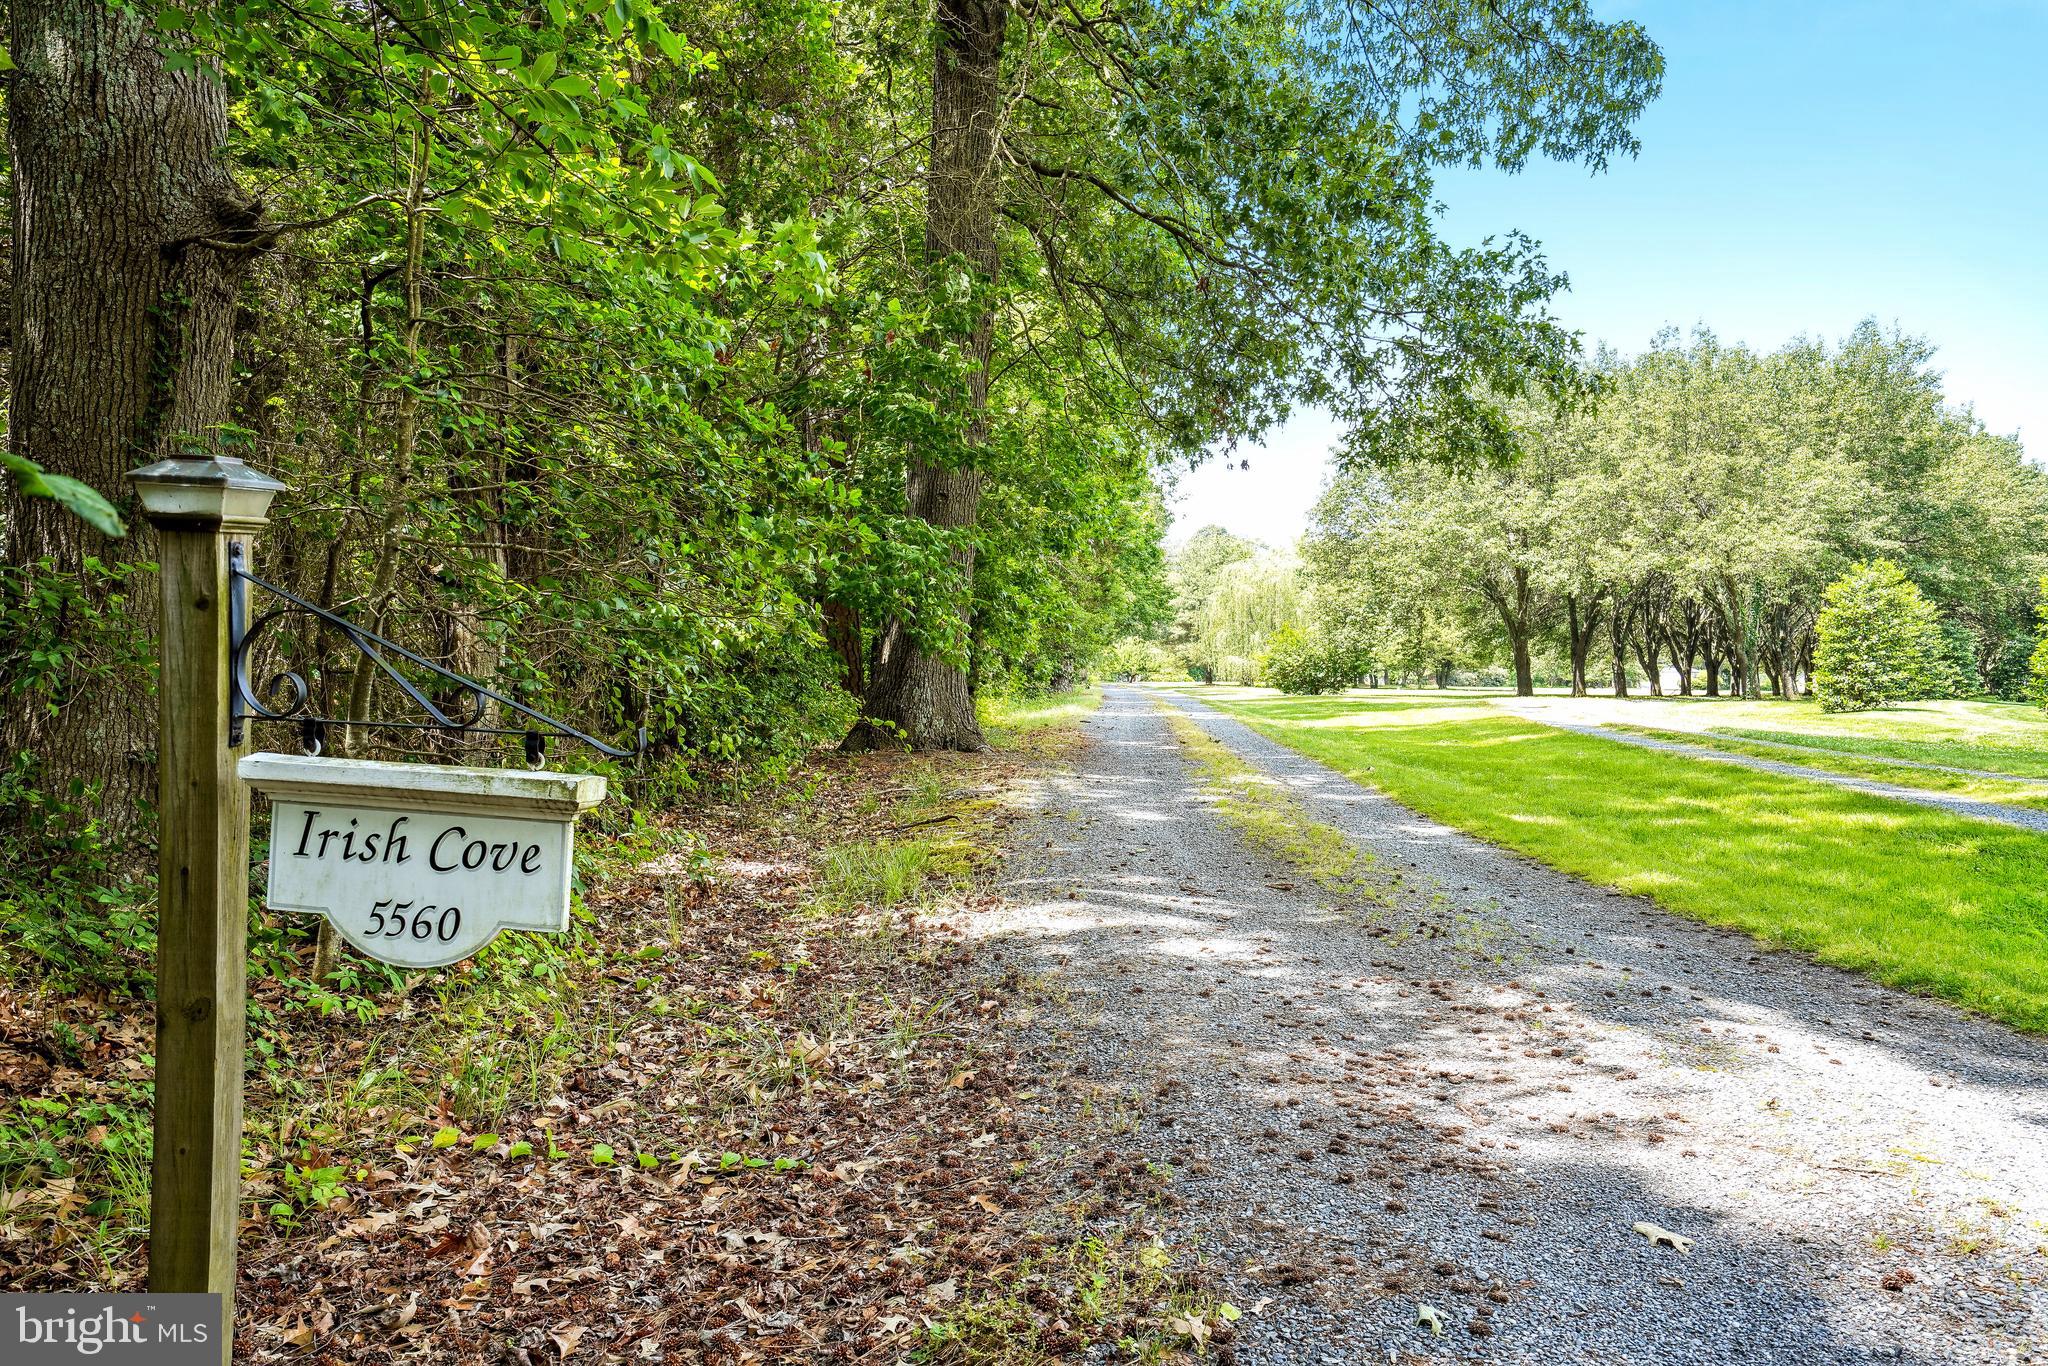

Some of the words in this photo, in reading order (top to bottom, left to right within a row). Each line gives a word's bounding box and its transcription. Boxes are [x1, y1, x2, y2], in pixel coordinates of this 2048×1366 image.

[292, 810, 411, 864] Irish
[429, 826, 541, 874] Cove
[363, 899, 461, 942] 5560
